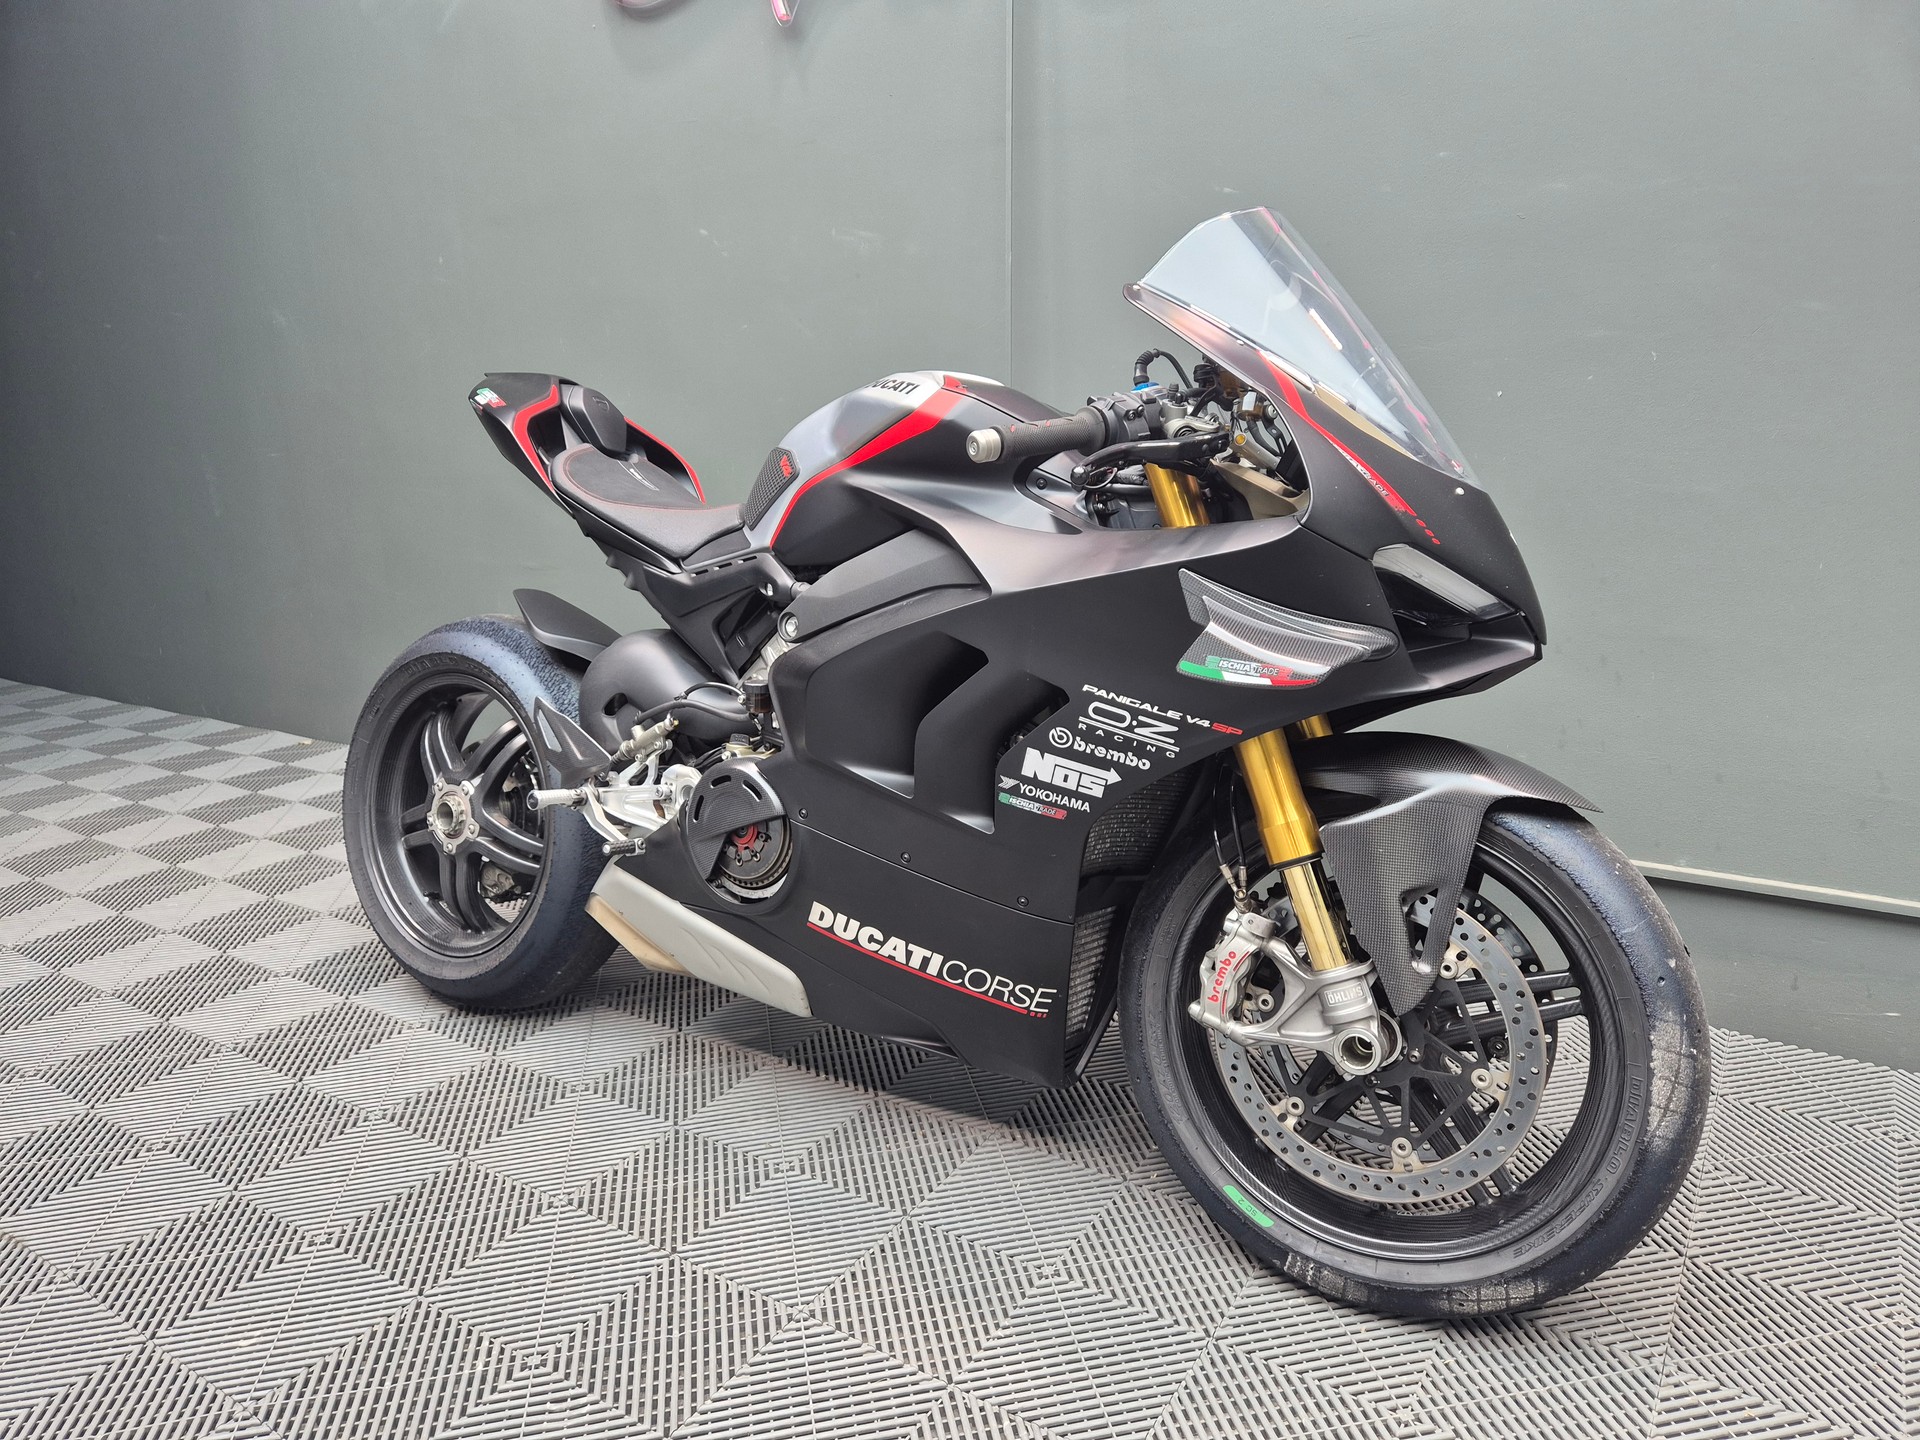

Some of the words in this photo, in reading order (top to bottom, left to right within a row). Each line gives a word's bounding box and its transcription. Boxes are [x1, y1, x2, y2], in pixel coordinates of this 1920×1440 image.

[863, 379, 920, 395] UCATI
[1082, 684, 1183, 720] PANIGALE
[1073, 736, 1151, 770] brembo
[1078, 722, 1176, 758] RACING
[1021, 747, 1107, 798] NOS
[1018, 783, 1090, 813] YOKOHAMA
[1207, 950, 1237, 1004] brembo
[1245, 1204, 1258, 1217] SC
